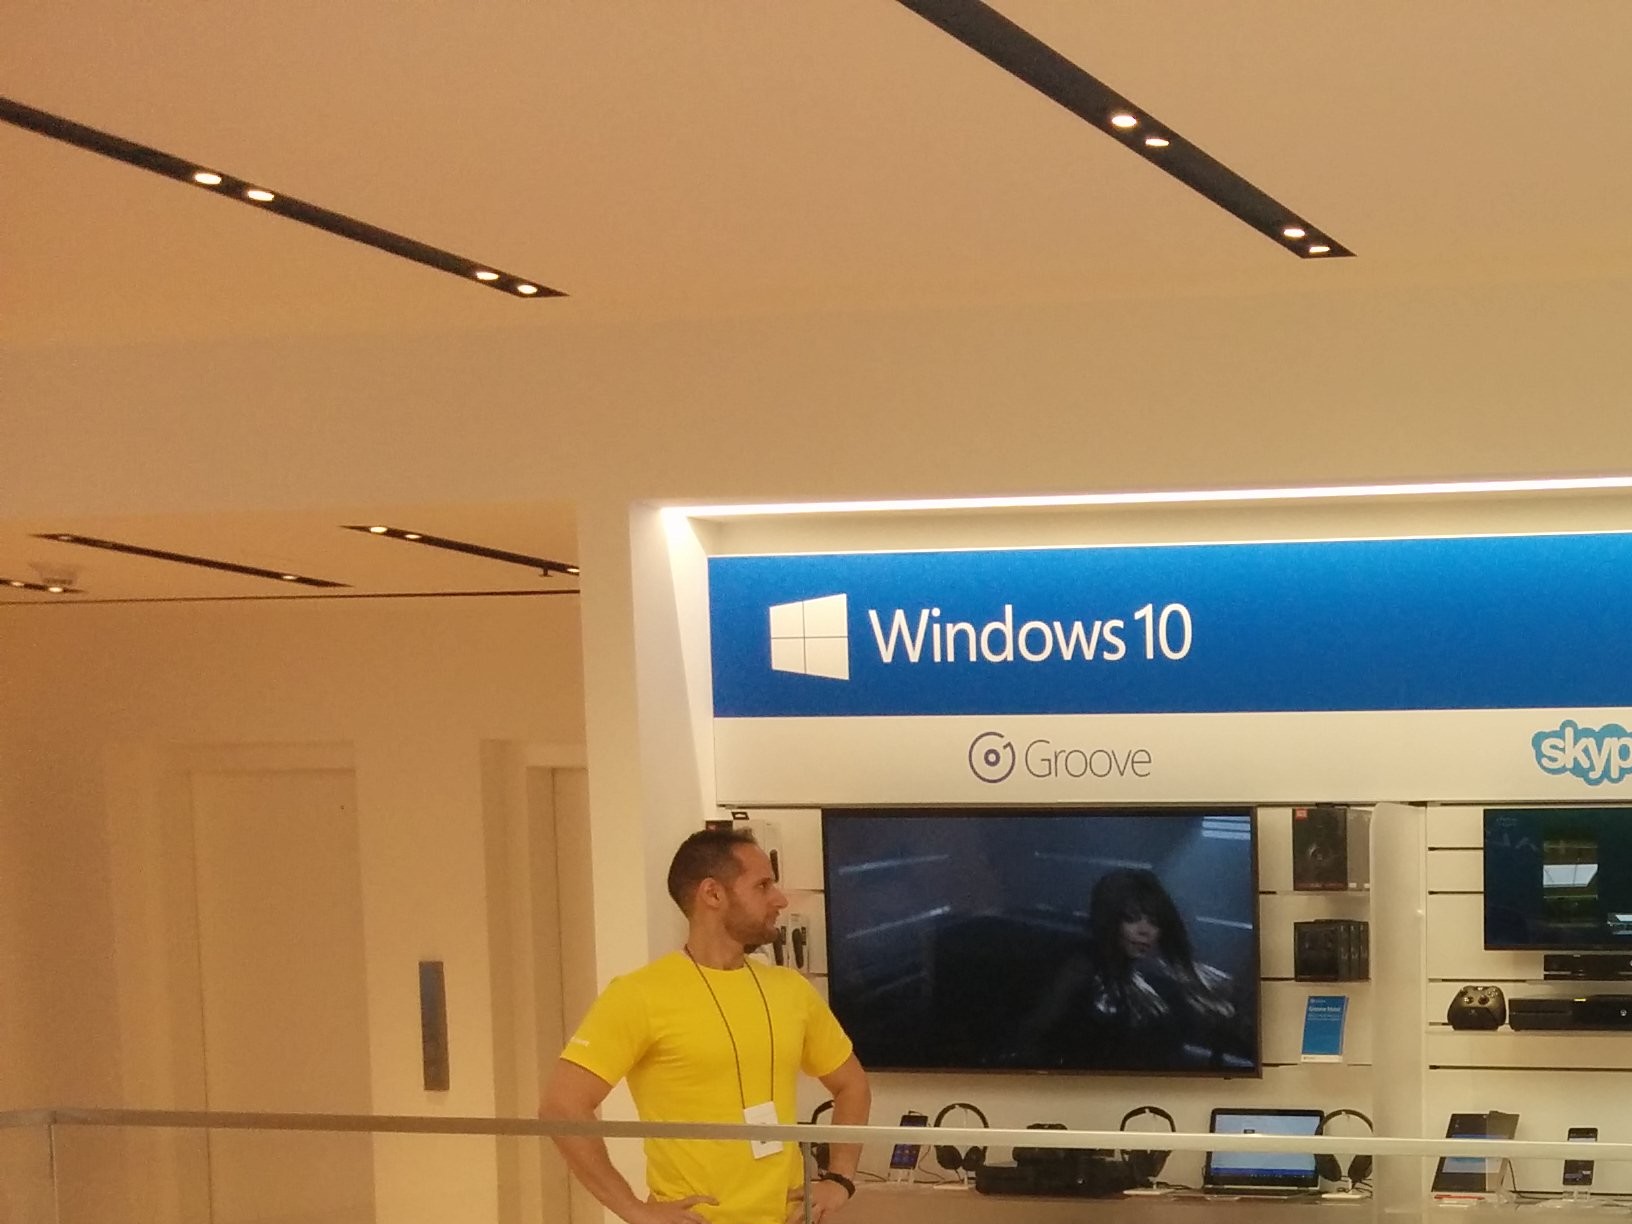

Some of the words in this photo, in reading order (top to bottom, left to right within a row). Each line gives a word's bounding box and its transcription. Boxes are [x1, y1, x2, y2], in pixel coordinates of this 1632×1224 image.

[868, 604, 1127, 663] Windows
[1133, 603, 1193, 660] 10
[1024, 739, 1152, 778] Groove
